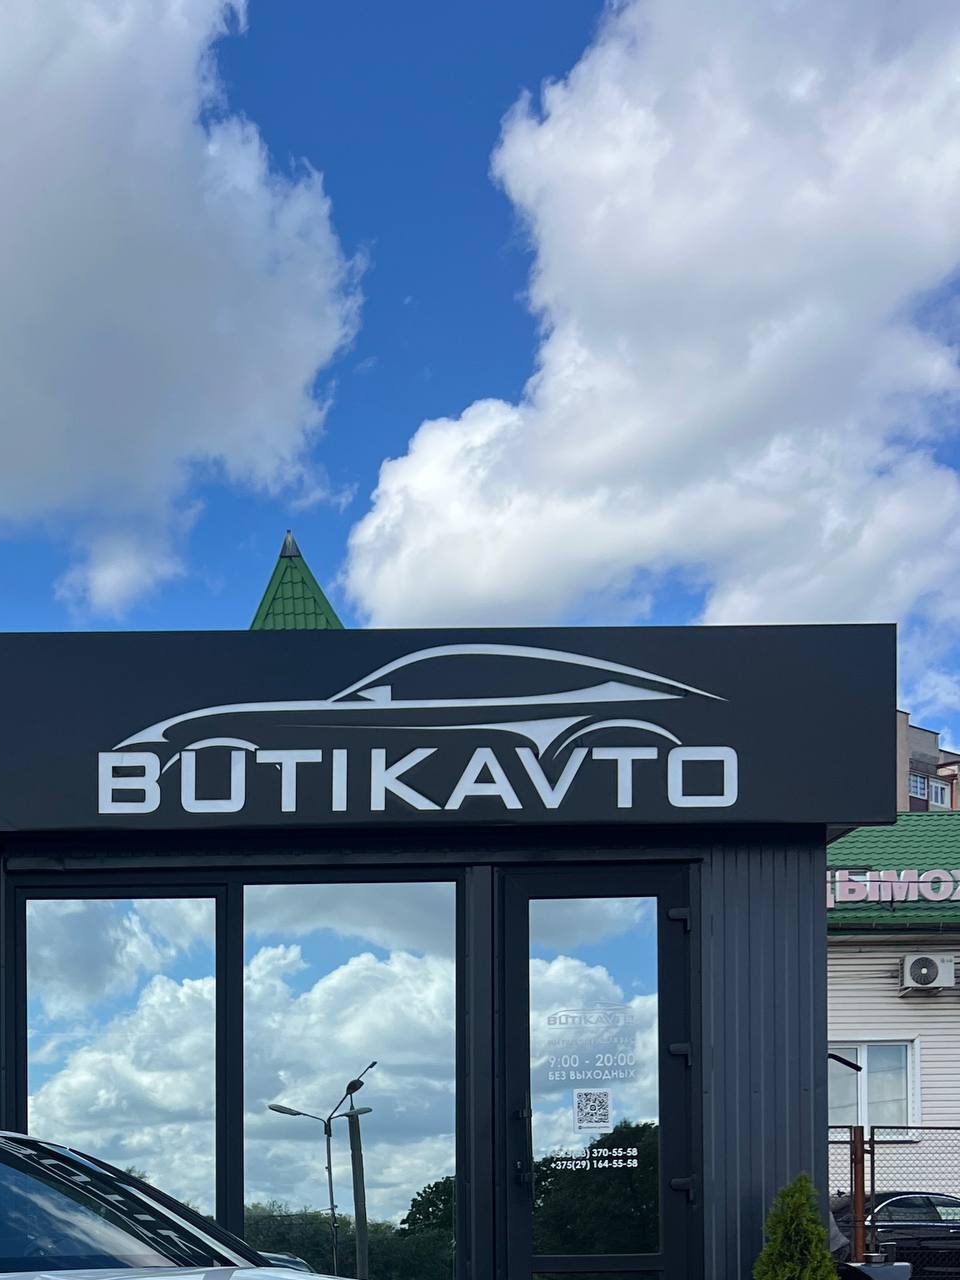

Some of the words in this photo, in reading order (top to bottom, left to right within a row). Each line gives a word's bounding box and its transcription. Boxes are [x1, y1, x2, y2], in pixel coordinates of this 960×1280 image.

[98, 746, 739, 814] BUTIKAVTO
[827, 869, 960, 908] ЫМО
[548, 1055, 579, 1068] 9:00
[595, 1053, 636, 1067] 20:00
[548, 1071, 566, 1081] БЕЗ
[569, 1069, 637, 1080] ВЫХОДНЫХ
[592, 1148, 638, 1157] 370-55-58
[550, 1160, 590, 1171] +375(29)
[592, 1159, 638, 1168] 164-55-58
